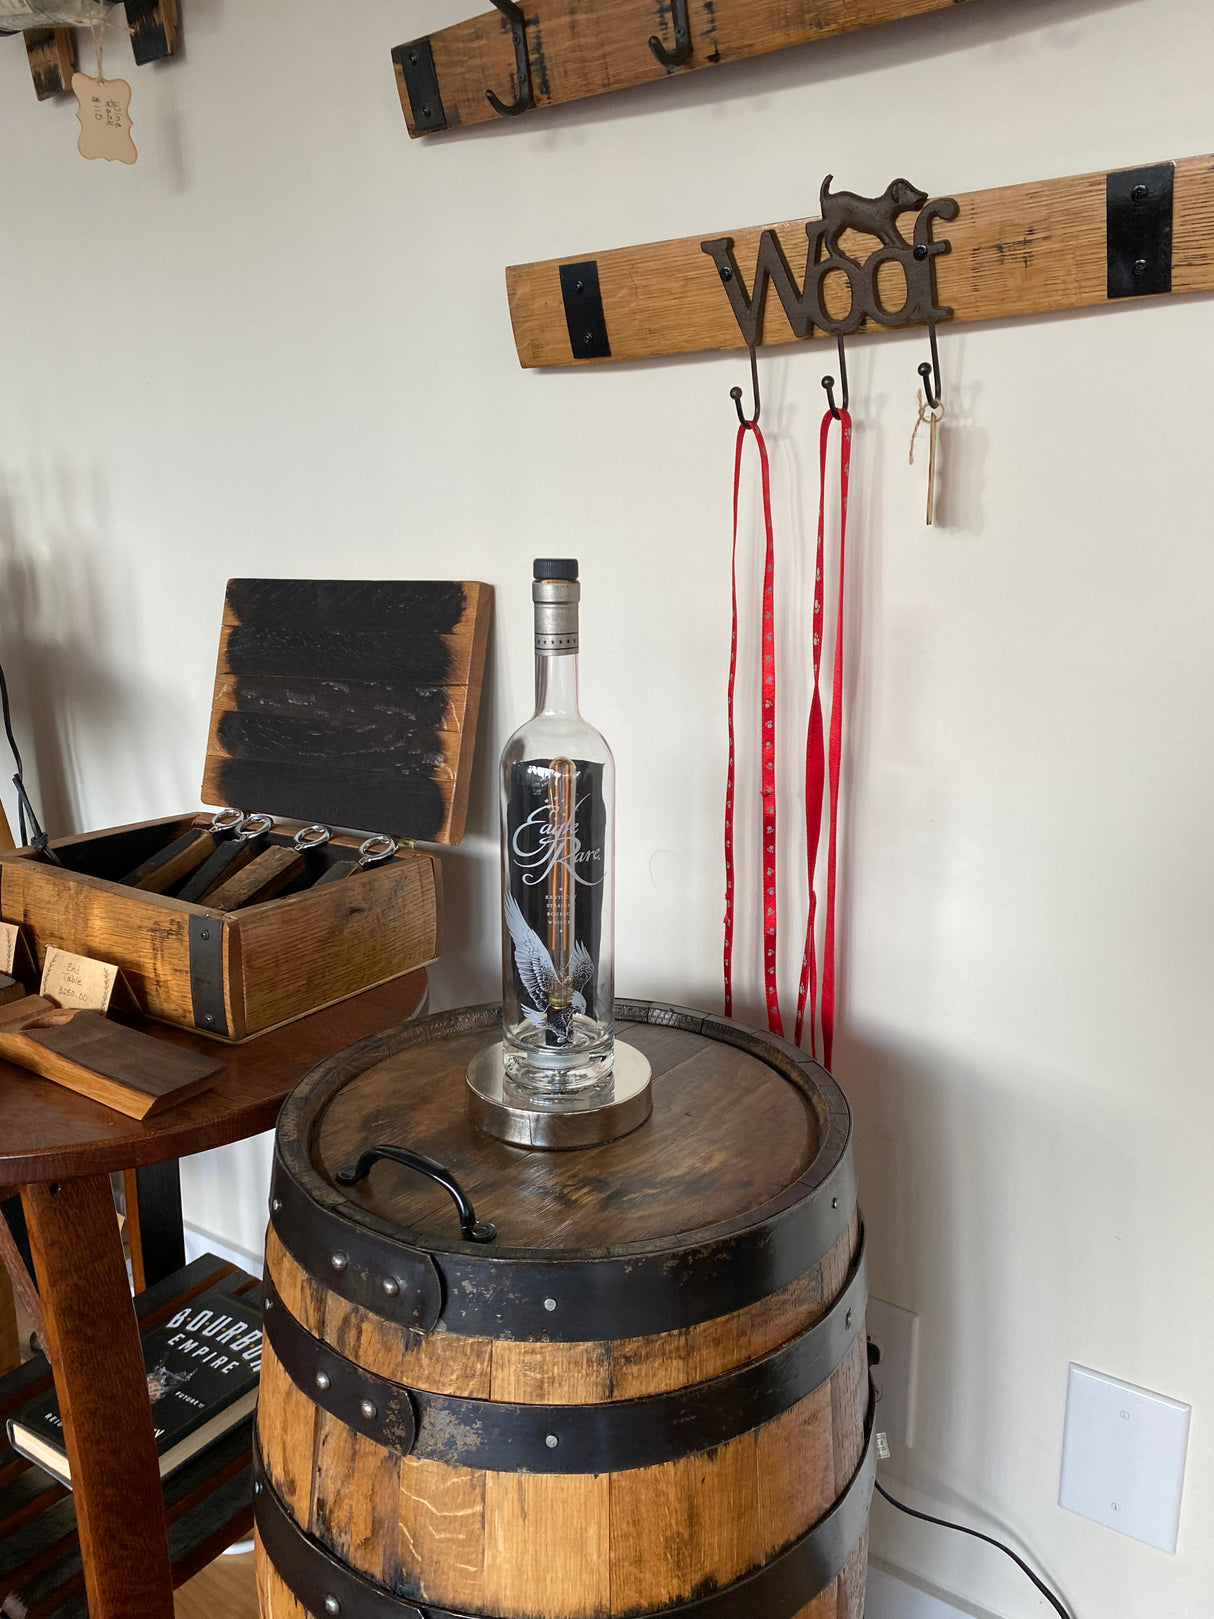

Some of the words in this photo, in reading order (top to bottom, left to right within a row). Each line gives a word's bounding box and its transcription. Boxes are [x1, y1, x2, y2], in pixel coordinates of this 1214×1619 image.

[113, 101, 122, 128] Wine
[701, 197, 960, 346] Woof
[513, 793, 591, 868] Eagle
[62, 971, 82, 986] Table
[66, 962, 80, 975] End
[167, 1333, 240, 1374] EMPIRE
